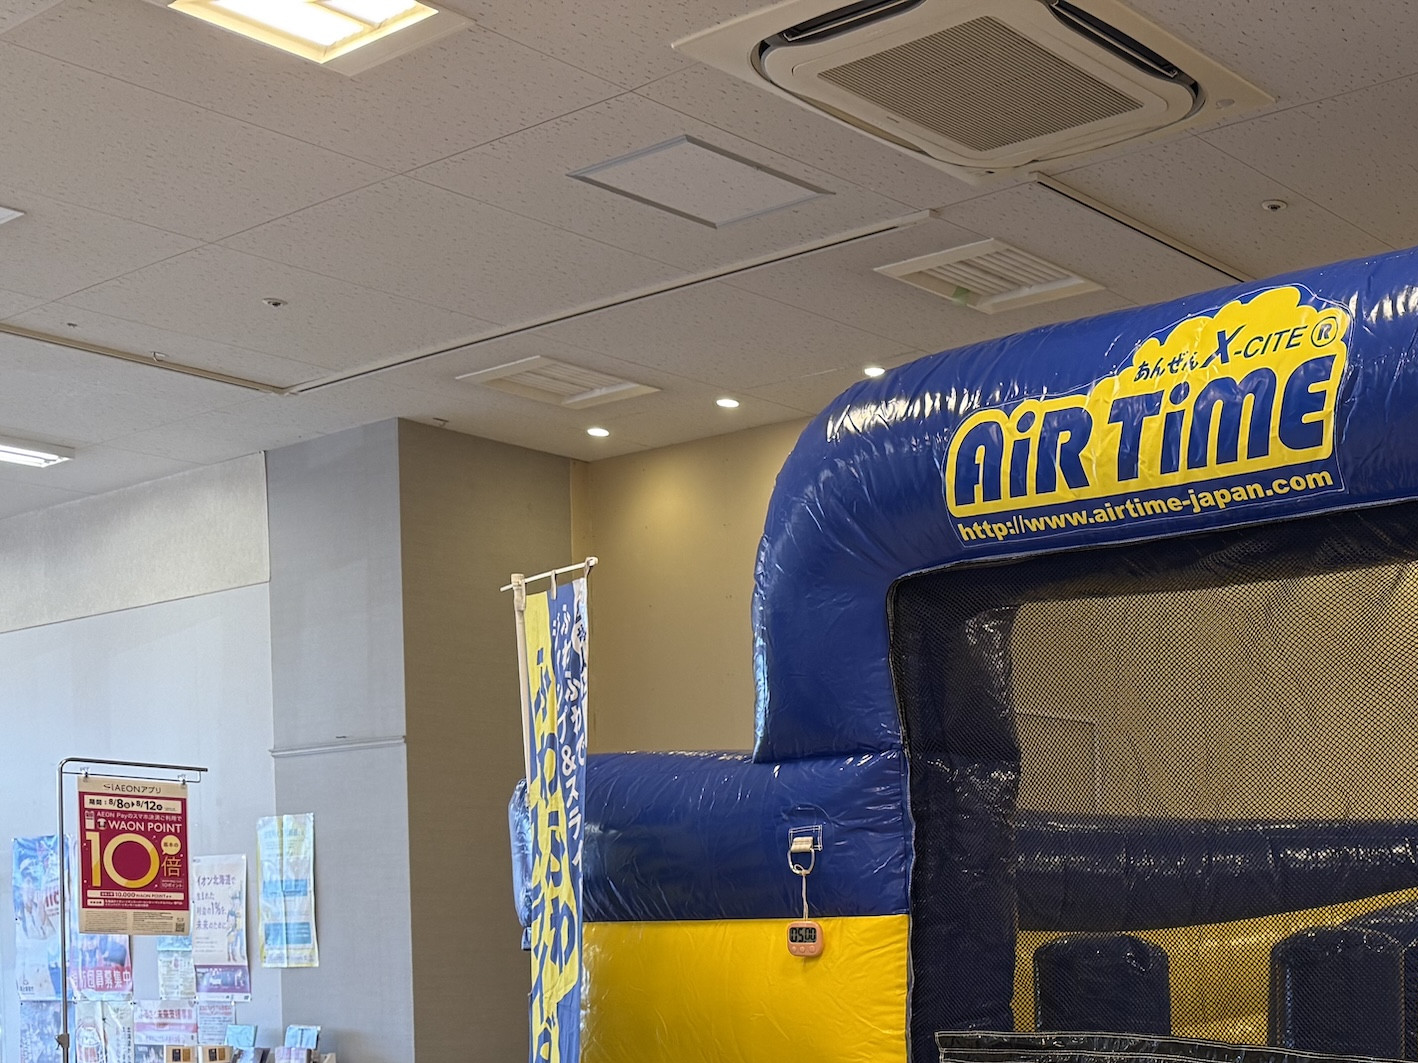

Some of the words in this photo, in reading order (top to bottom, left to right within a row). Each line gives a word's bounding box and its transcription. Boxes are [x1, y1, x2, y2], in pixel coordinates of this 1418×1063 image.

[957, 471, 1333, 541] http://www.airtime-japan.com
[108, 820, 147, 831] WAON
[148, 823, 183, 833] POINT
